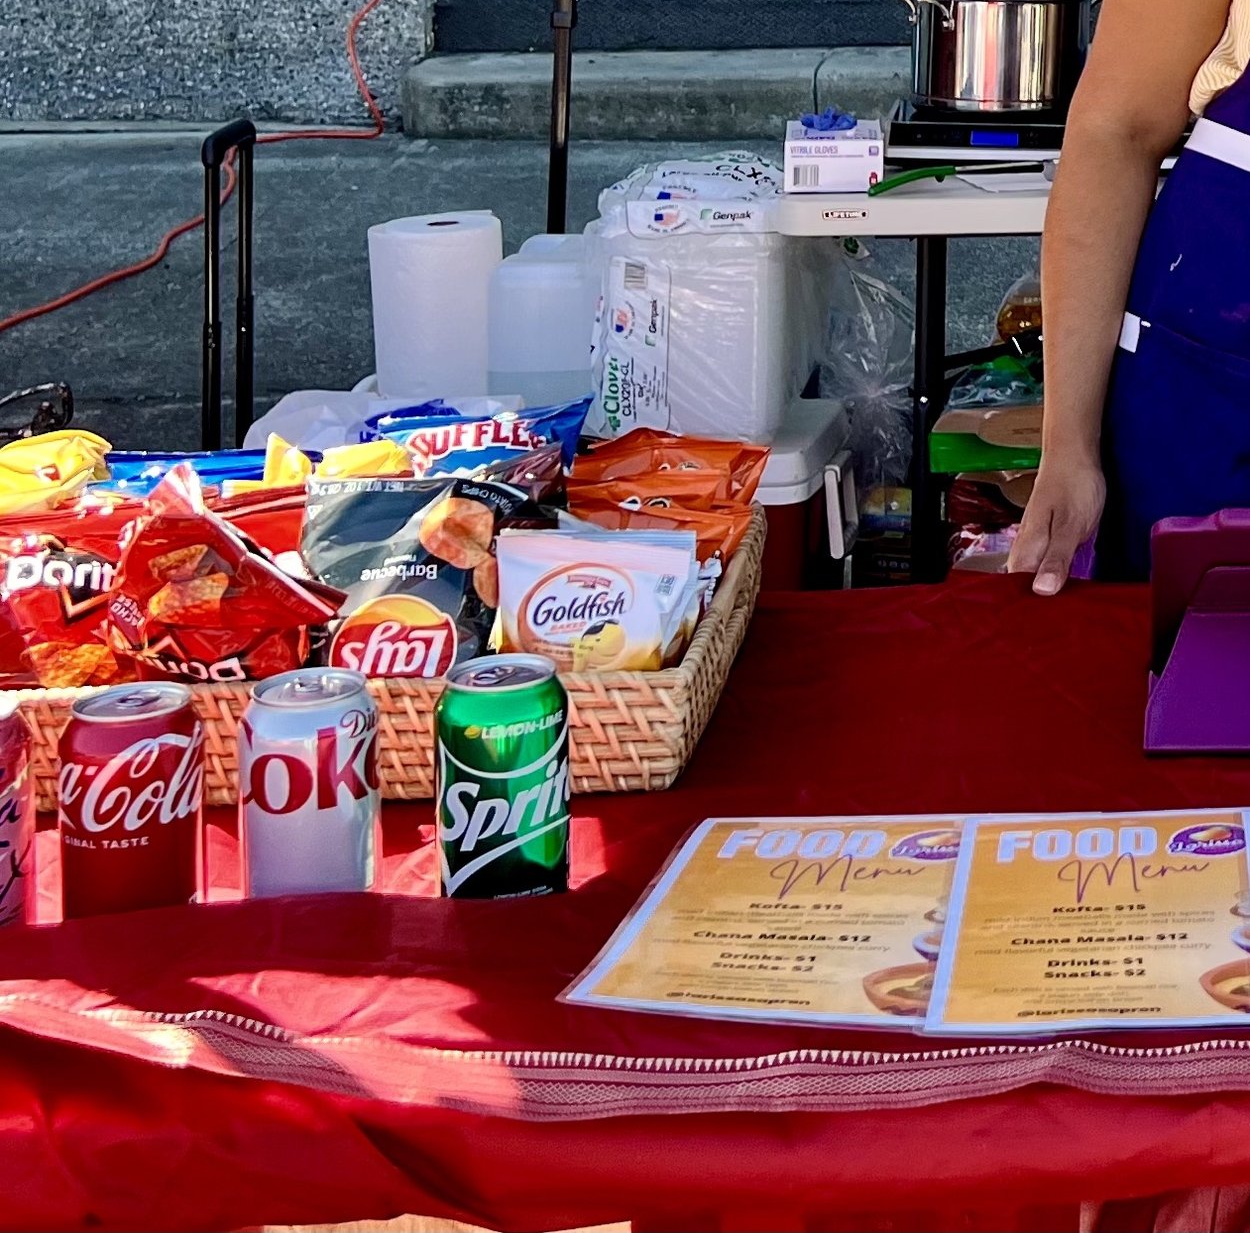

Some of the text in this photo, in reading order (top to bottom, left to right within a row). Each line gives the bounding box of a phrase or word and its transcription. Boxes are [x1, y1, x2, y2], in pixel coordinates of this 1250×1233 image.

[814, 146, 838, 154] GLOVES
[713, 209, 751, 221] Genpak
[5, 554, 117, 592] Dorit
[360, 563, 438, 581] Barbecue
[533, 591, 625, 626] Goldfish
[341, 621, 449, 677] Lays
[341, 707, 378, 738] Di
[481, 709, 563, 740] LEMON-LIME
[102, 836, 150, 849] TASTE
[717, 829, 888, 860] FOOD
[997, 826, 1157, 863] FOOD
[770, 853, 926, 901] Menu
[1057, 852, 1210, 903] Menu
[1052, 904, 1110, 913] Kofta-
[693, 930, 753, 939] Chana
[1011, 936, 1071, 945] Chana
[1076, 934, 1151, 943] Masala-
[1044, 969, 1119, 979] Snacks-
[1047, 958, 1118, 968] Drinks-
